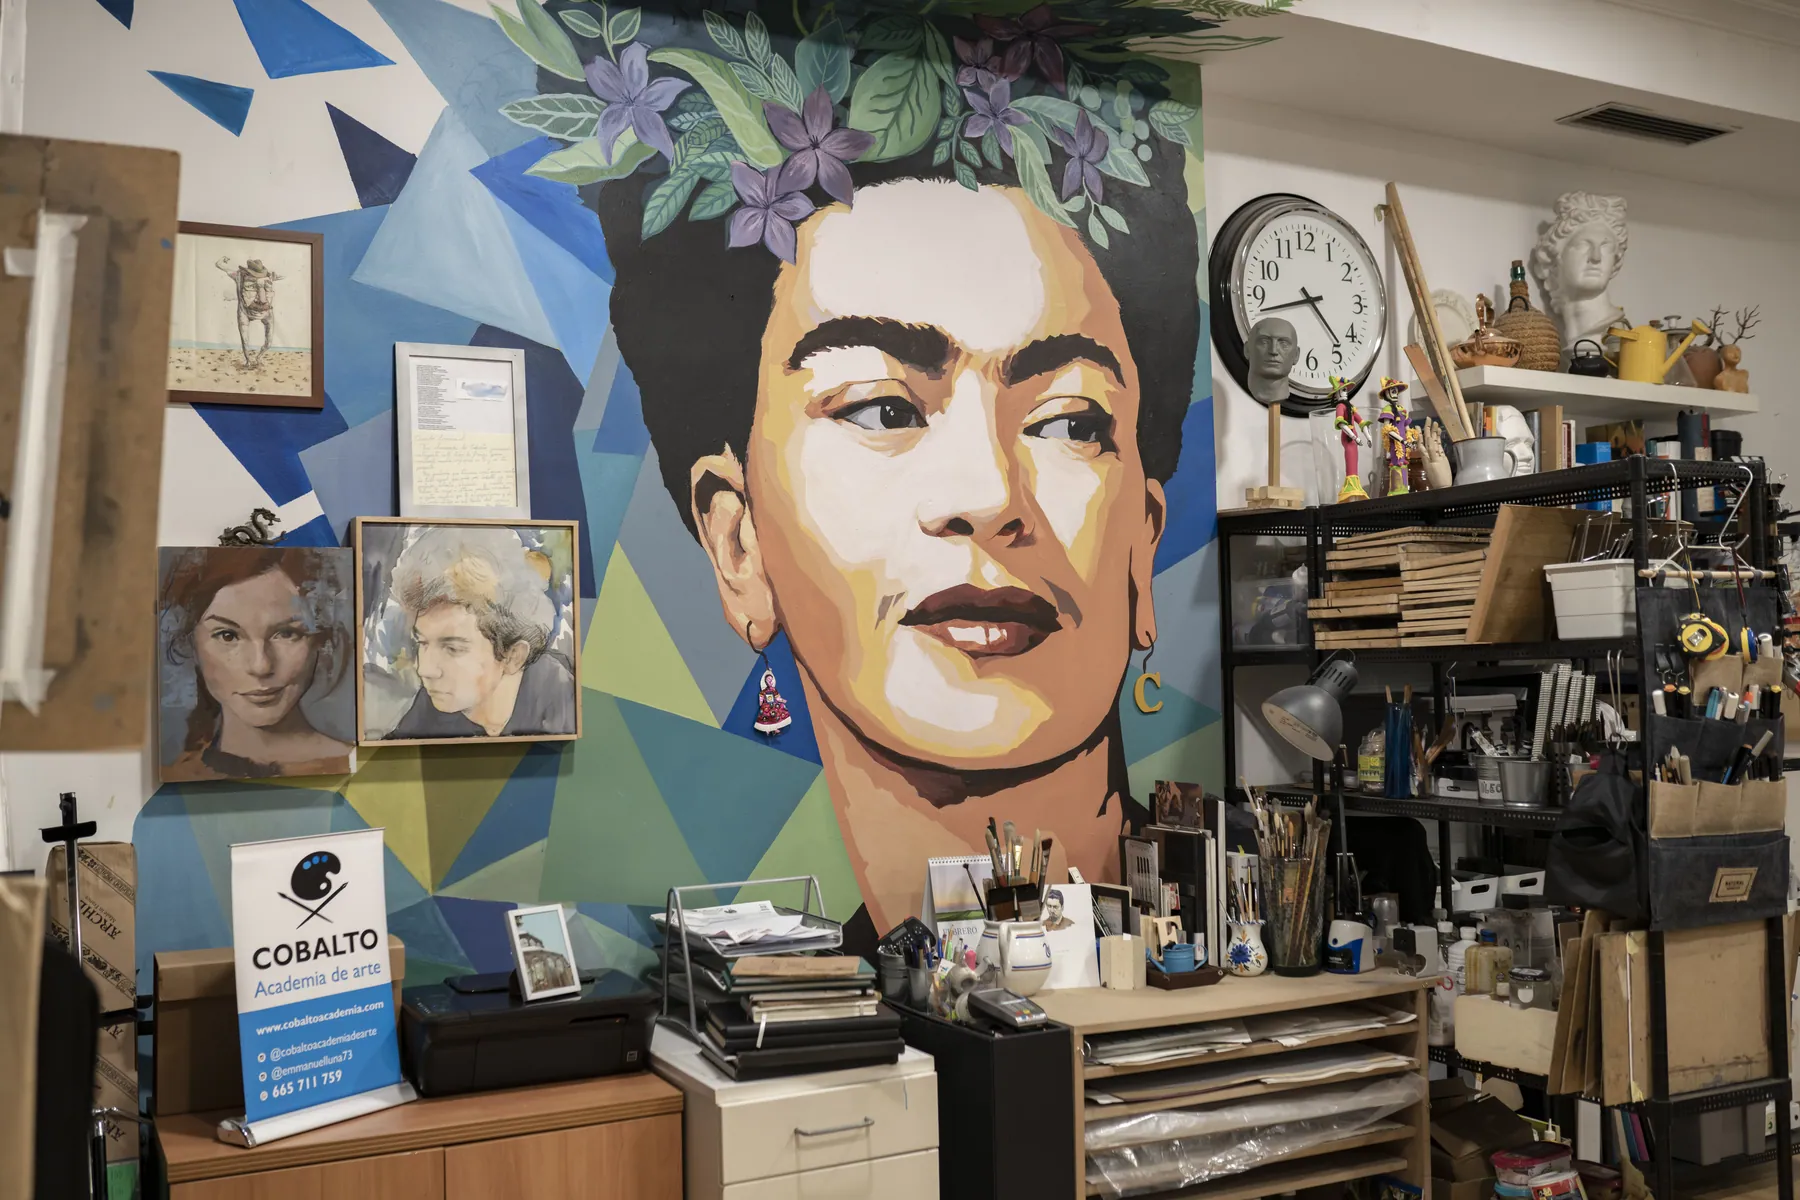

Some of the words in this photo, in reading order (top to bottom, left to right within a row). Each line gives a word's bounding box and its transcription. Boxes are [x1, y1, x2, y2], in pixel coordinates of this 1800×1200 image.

[1276, 238, 1293, 260] 11
[1295, 231, 1315, 253] 12
[1325, 242, 1334, 262] 1
[1259, 260, 1279, 281] 10
[1340, 262, 1352, 283] 2
[1252, 285, 1266, 308] 9
[1352, 294, 1363, 314] 3
[1345, 322, 1357, 343] 4
[1305, 348, 1318, 371] 6
[1331, 343, 1343, 364] 5
[1133, 671, 1164, 713] C
[252, 928, 378, 970] COBALTO
[254, 971, 326, 998] Academia
[331, 966, 348, 982] de
[353, 962, 381, 978] arte
[256, 1001, 384, 1035] www.cobaltoacademia.com
[270, 1028, 377, 1061] @cobaltoacademiadearte
[271, 1049, 353, 1080] @emmanuelluna73
[272, 1081, 294, 1098] 665
[297, 1075, 317, 1091] 711
[321, 1069, 342, 1085] 759
